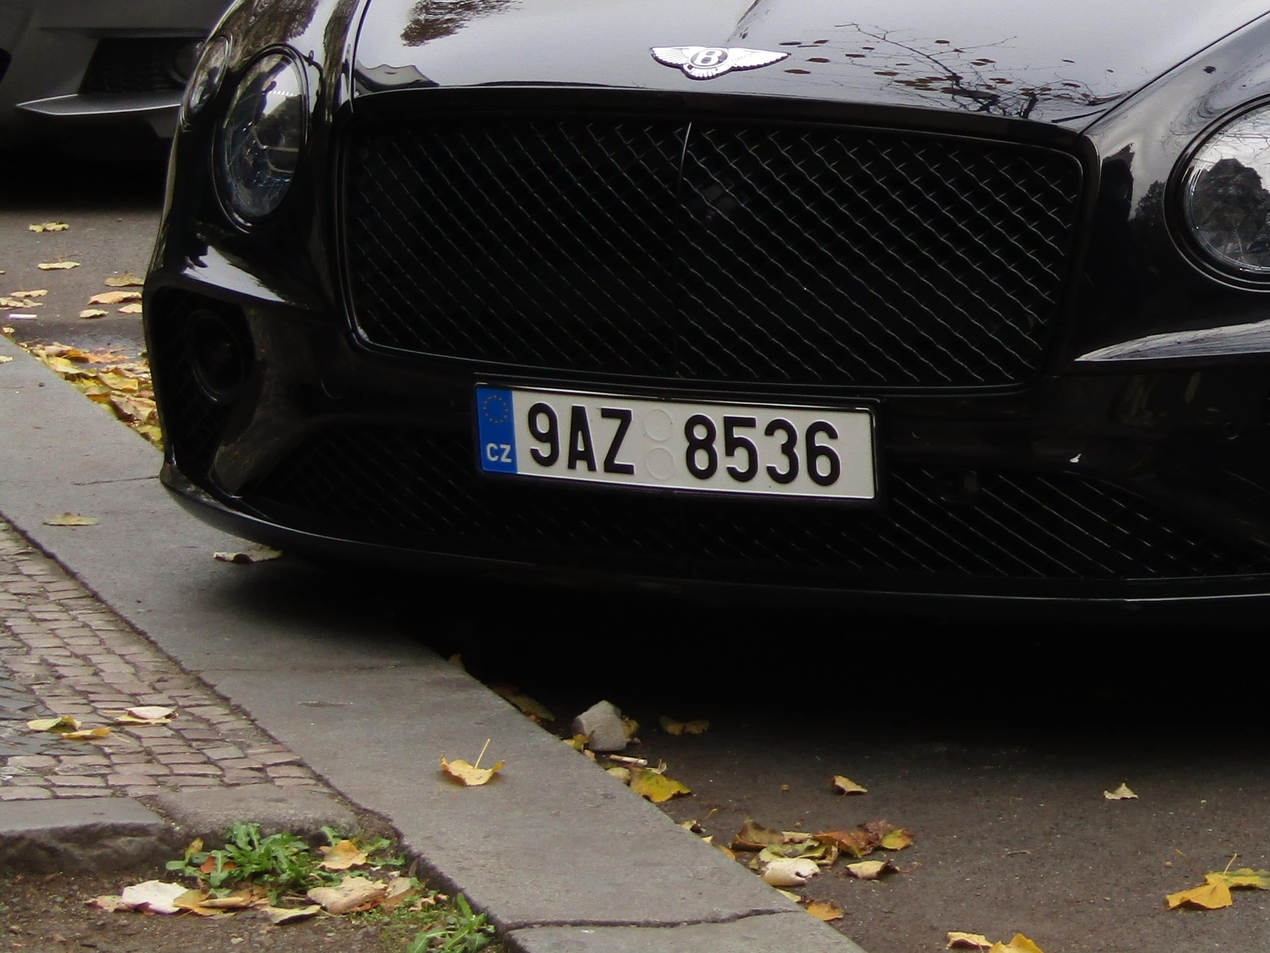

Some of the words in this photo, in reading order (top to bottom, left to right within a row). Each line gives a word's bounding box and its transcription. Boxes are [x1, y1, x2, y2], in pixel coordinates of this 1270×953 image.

[486, 441, 512, 463] CZ
[527, 402, 635, 475] 9AZ
[685, 414, 841, 486] 8536
